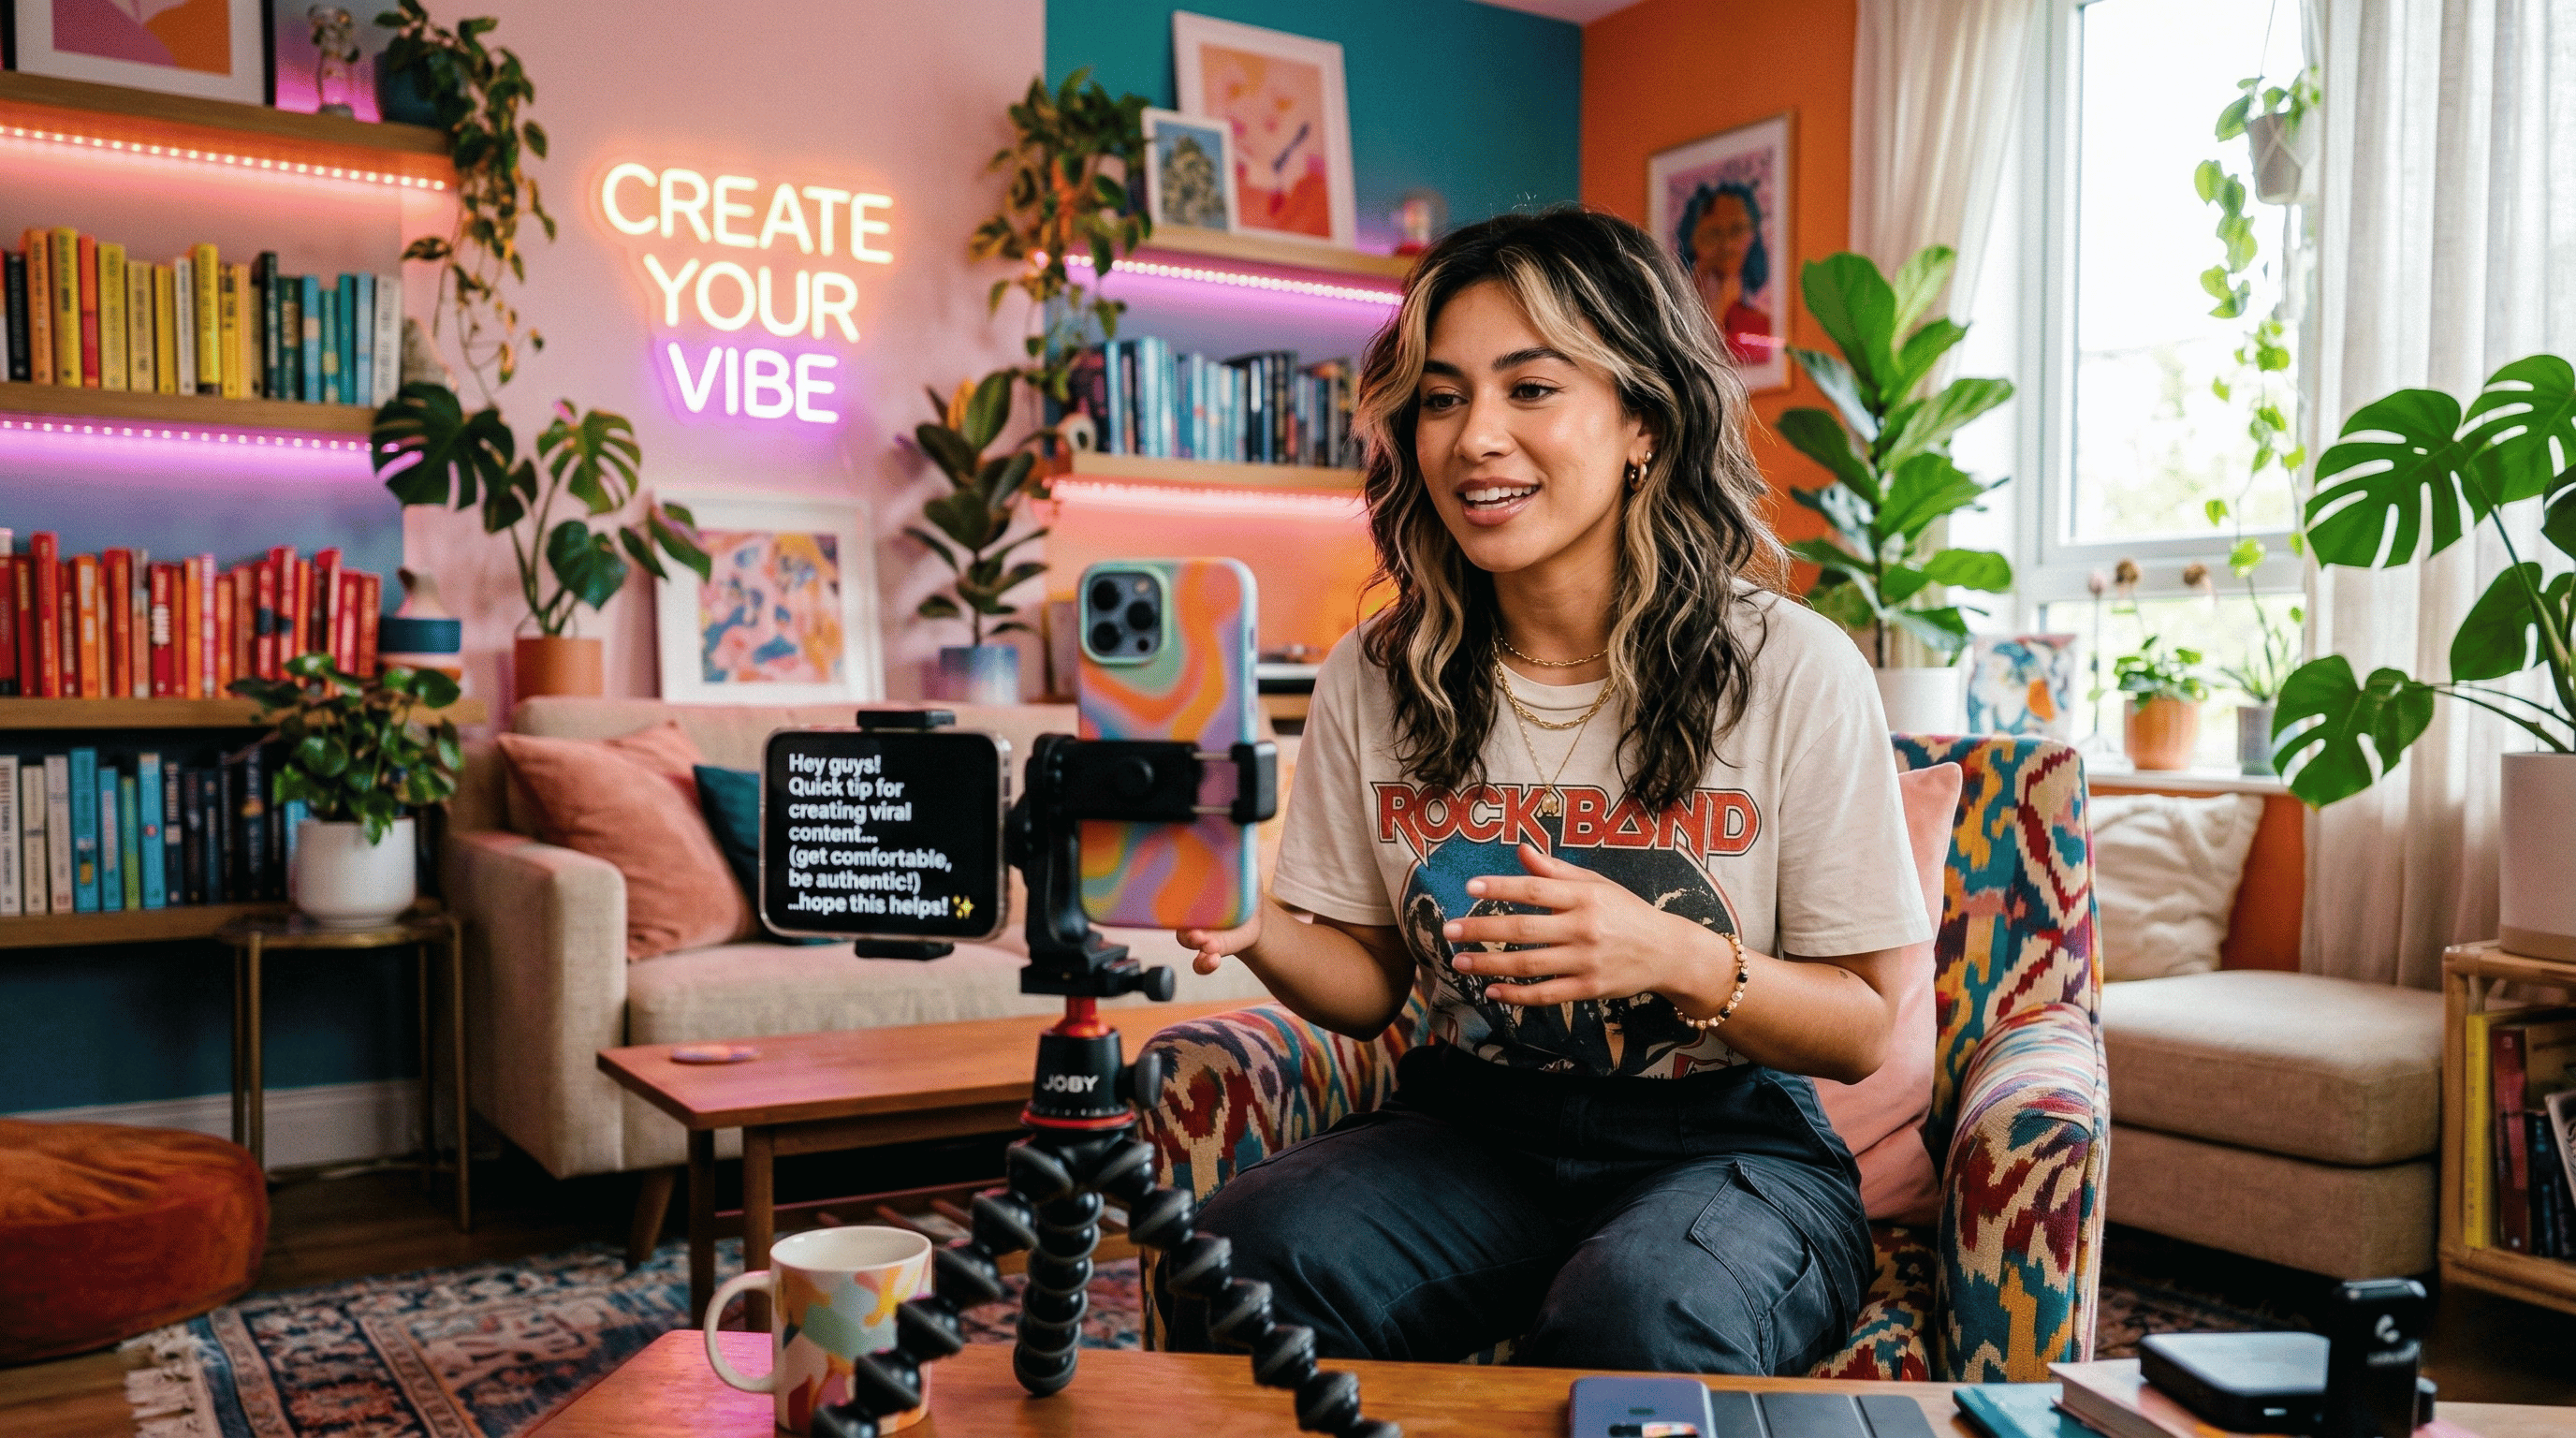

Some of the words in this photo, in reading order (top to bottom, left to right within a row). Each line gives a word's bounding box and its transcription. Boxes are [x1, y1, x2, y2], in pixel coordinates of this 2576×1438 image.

[602, 162, 894, 264] CREATE
[643, 254, 861, 343] YOUR
[667, 341, 840, 423] VIBE
[788, 753, 827, 776] Hey
[828, 755, 882, 777] guys!
[788, 776, 844, 797] Quick
[846, 776, 873, 800] tip
[875, 777, 905, 798] for
[788, 800, 868, 825] creating
[869, 800, 913, 821] viral
[788, 824, 879, 844] content...
[1370, 781, 1553, 871] ROCK
[1559, 784, 1763, 873] BAND
[788, 844, 828, 869] (get
[829, 846, 953, 873] comfortable,
[788, 868, 814, 888] be
[815, 870, 922, 895] authentic!)
[849, 893, 887, 915] this
[888, 894, 949, 919] helps!
[1041, 1074, 1100, 1093] JOBY
